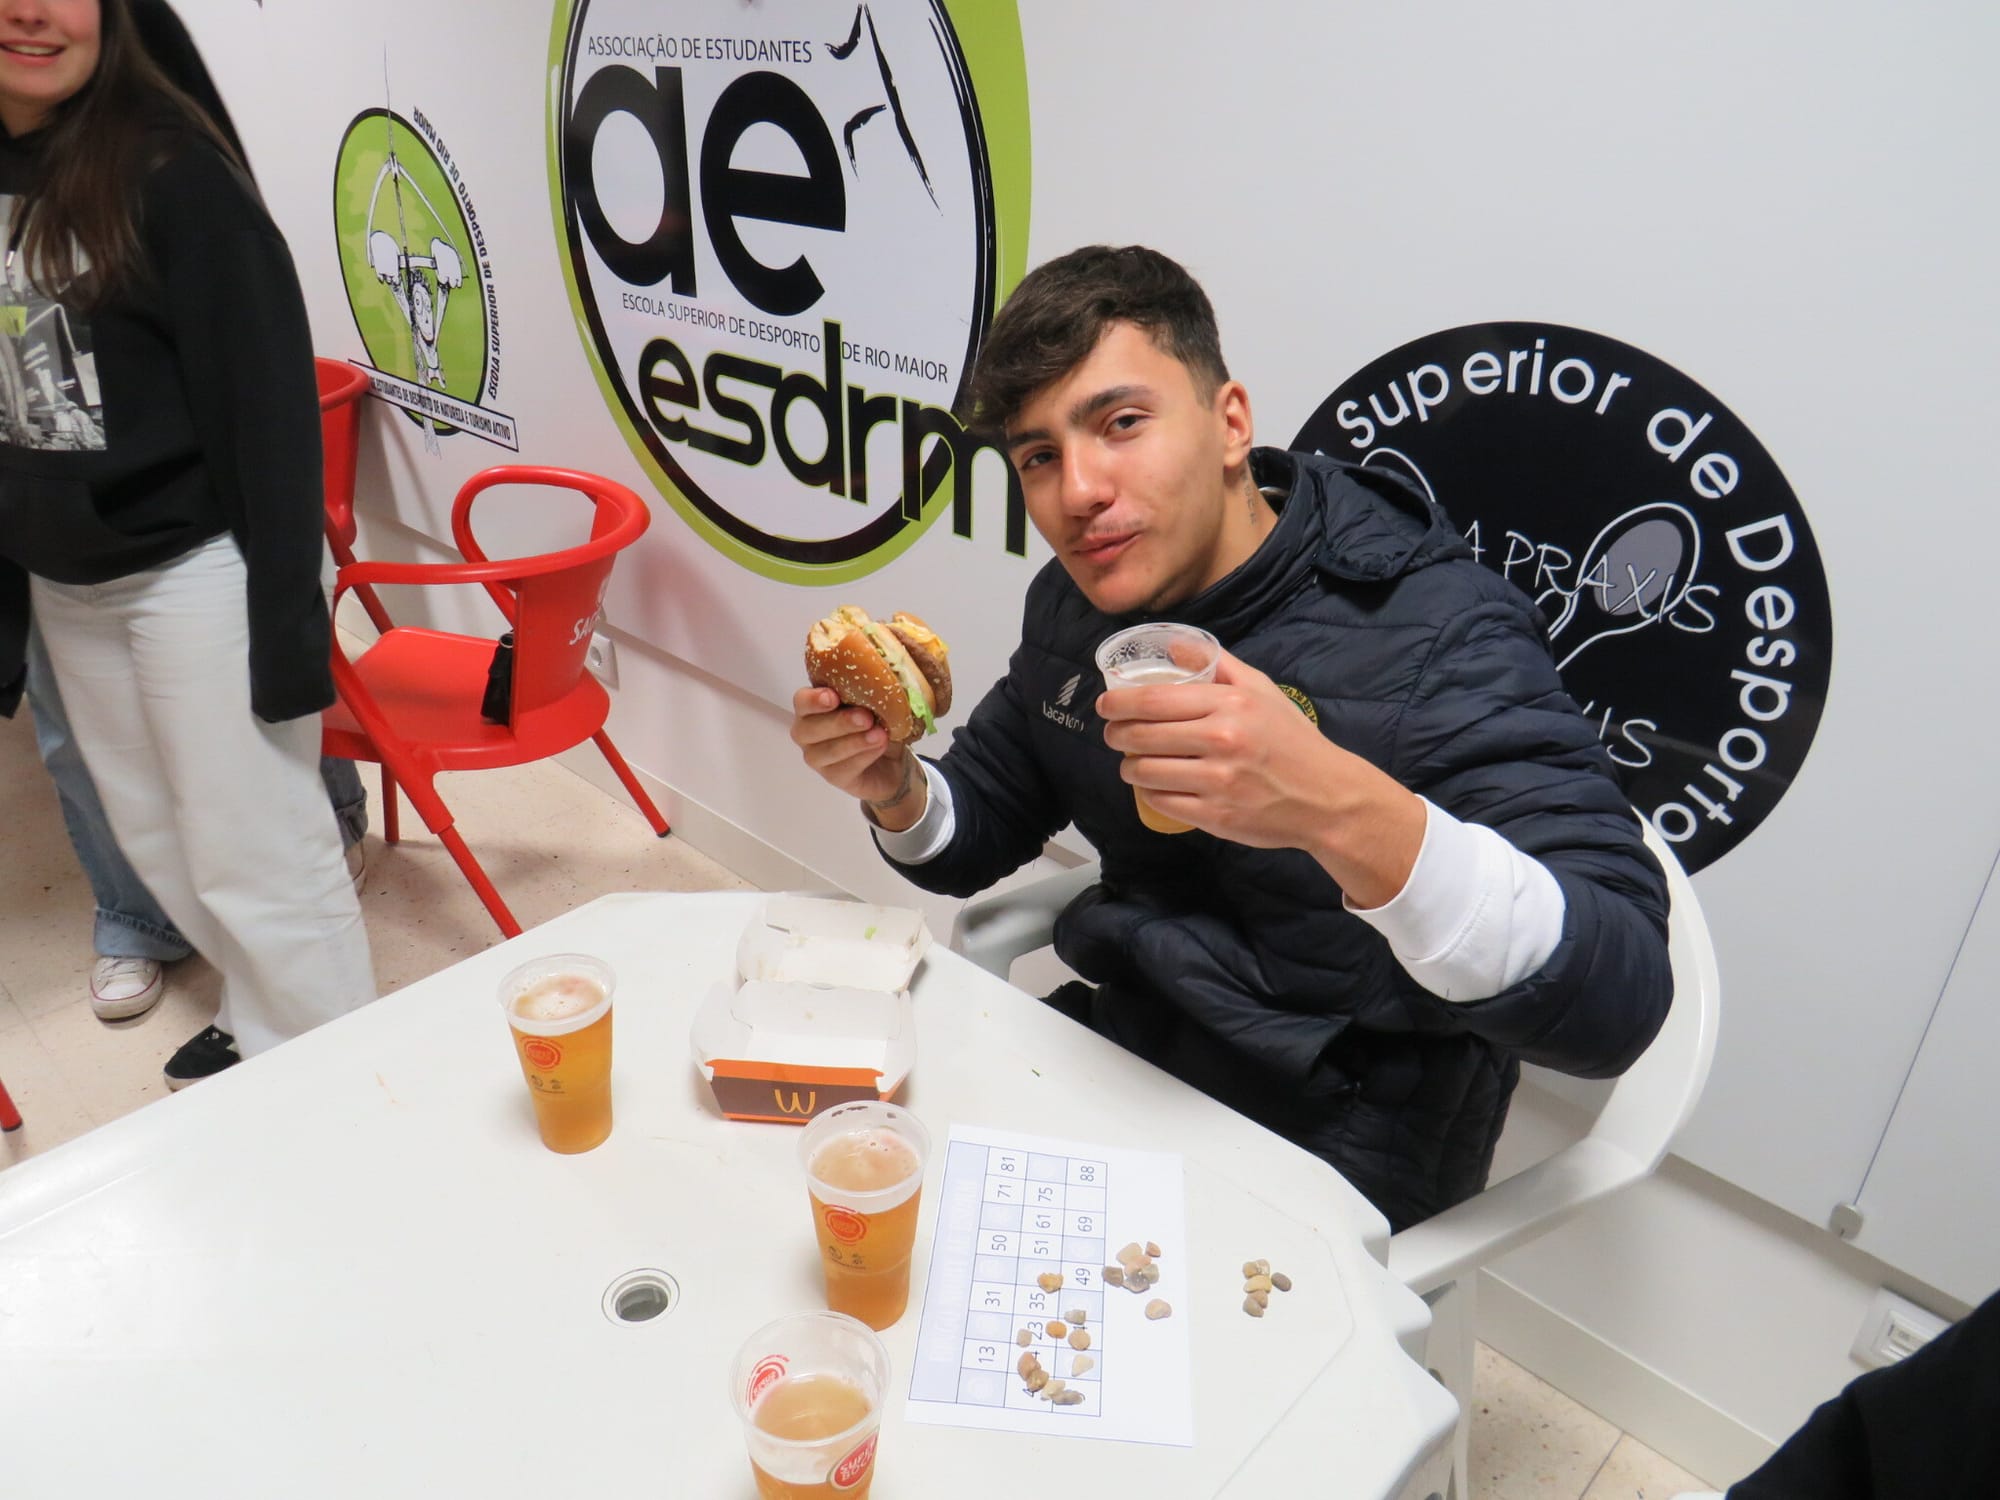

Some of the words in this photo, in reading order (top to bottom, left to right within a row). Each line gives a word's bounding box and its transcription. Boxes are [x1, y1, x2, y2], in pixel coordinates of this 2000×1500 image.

[588, 34, 678, 62] ASSOCIAÇÃO
[682, 37, 702, 59] DE
[705, 38, 812, 63] ESTUDANTES
[413, 105, 437, 143] MAIOR
[436, 138, 451, 165] RIO
[448, 161, 460, 183] DE
[458, 182, 488, 258] DESPORTO
[482, 260, 493, 279] DE
[486, 284, 501, 355] SUPERIOR
[622, 292, 666, 318] ESCOLA
[667, 302, 726, 332] SUPERIOR
[729, 316, 746, 336] DE
[749, 320, 821, 353] DESPORTO
[841, 341, 861, 363] DE
[865, 346, 891, 370] RIO
[894, 353, 948, 384] MAIOR
[488, 355, 501, 400] ESCOLA
[440, 401, 465, 422] NATUREZA
[468, 411, 492, 433] TURISMO
[492, 420, 510, 440] ACTIVO
[639, 318, 1027, 558] esdrm
[1645, 407, 1740, 499] de
[1502, 530, 1721, 634] PRAXIS
[1650, 512, 1797, 843] Desporto
[1000, 1155, 1016, 1172] 81
[1080, 1165, 1096, 1182] 88
[997, 1183, 1012, 1198] 71
[1038, 1186, 1053, 1202] 75
[1036, 1213, 1051, 1229] 61
[1078, 1215, 1093, 1232] 69
[991, 1234, 1008, 1251] 50
[1033, 1239, 1049, 1255] 51
[1075, 1267, 1091, 1286] 49
[985, 1289, 1001, 1307] 31
[1029, 1292, 1046, 1311] 35
[978, 1345, 995, 1364] 13
